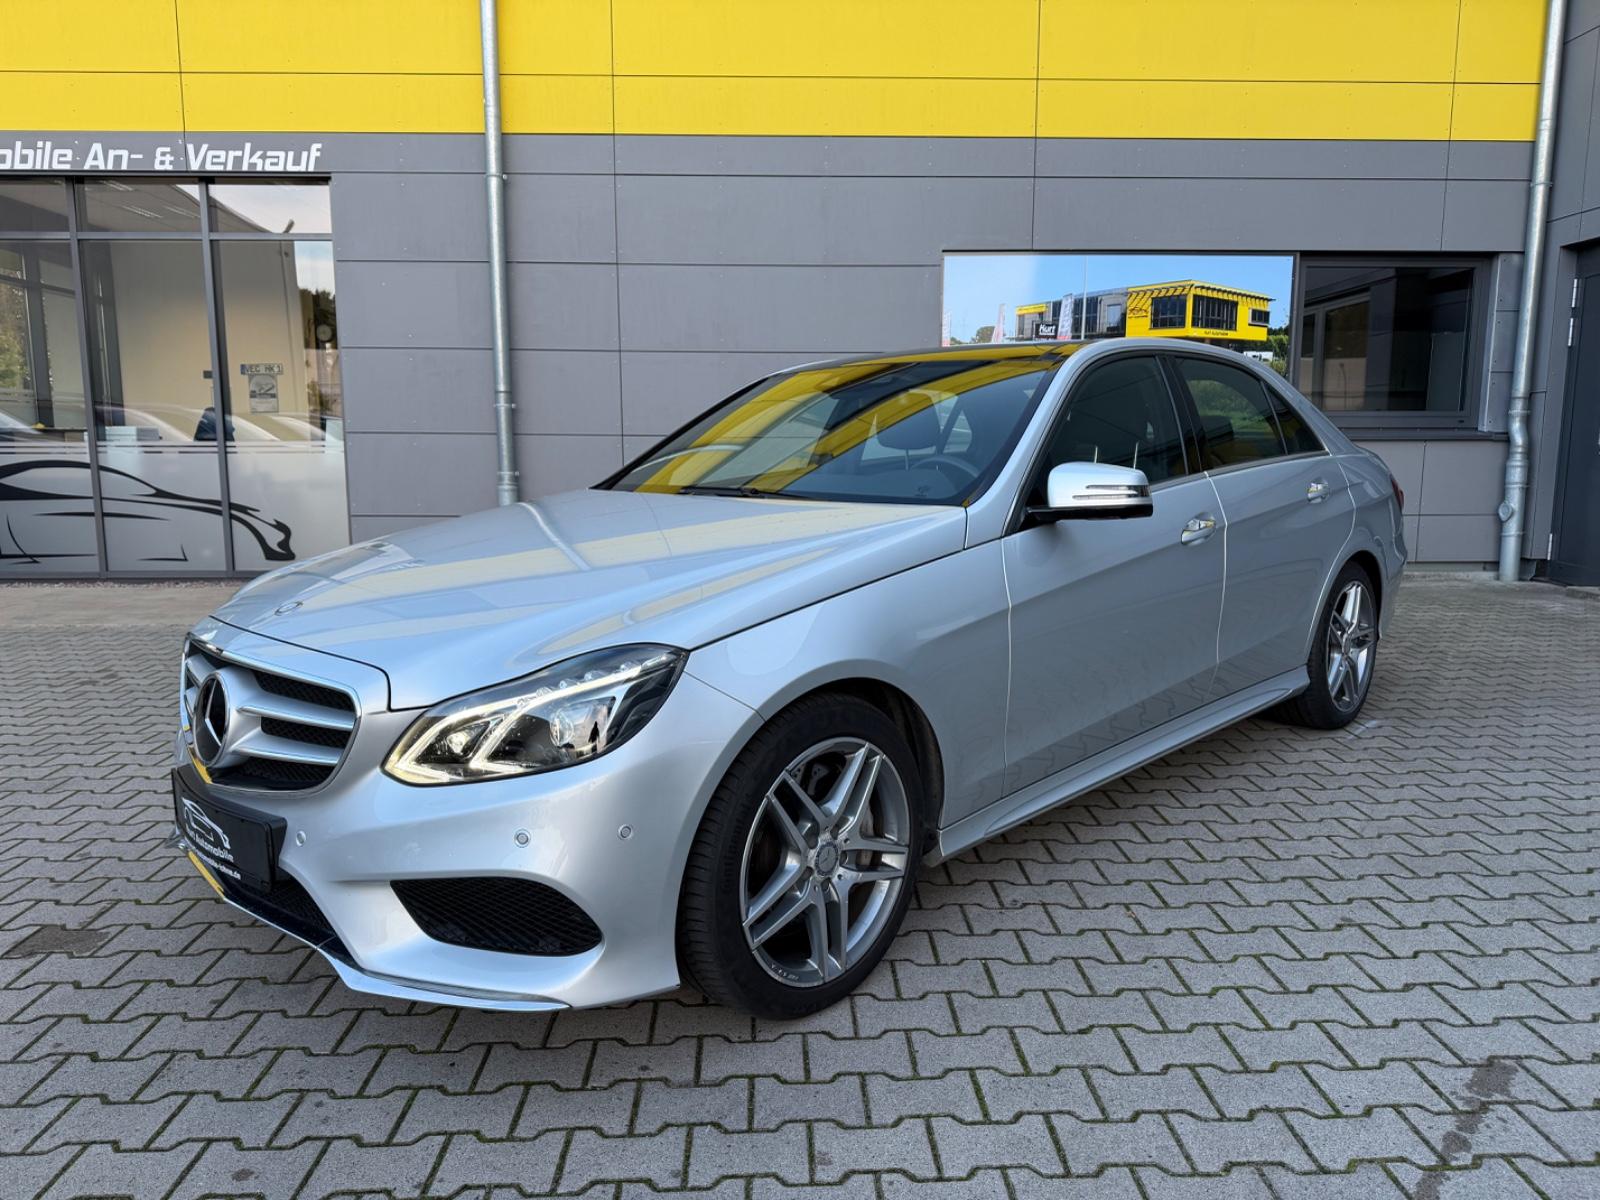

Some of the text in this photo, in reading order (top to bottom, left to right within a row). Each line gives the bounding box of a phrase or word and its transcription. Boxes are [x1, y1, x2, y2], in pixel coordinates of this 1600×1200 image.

[0, 141, 322, 172] obile An- & Verkauf
